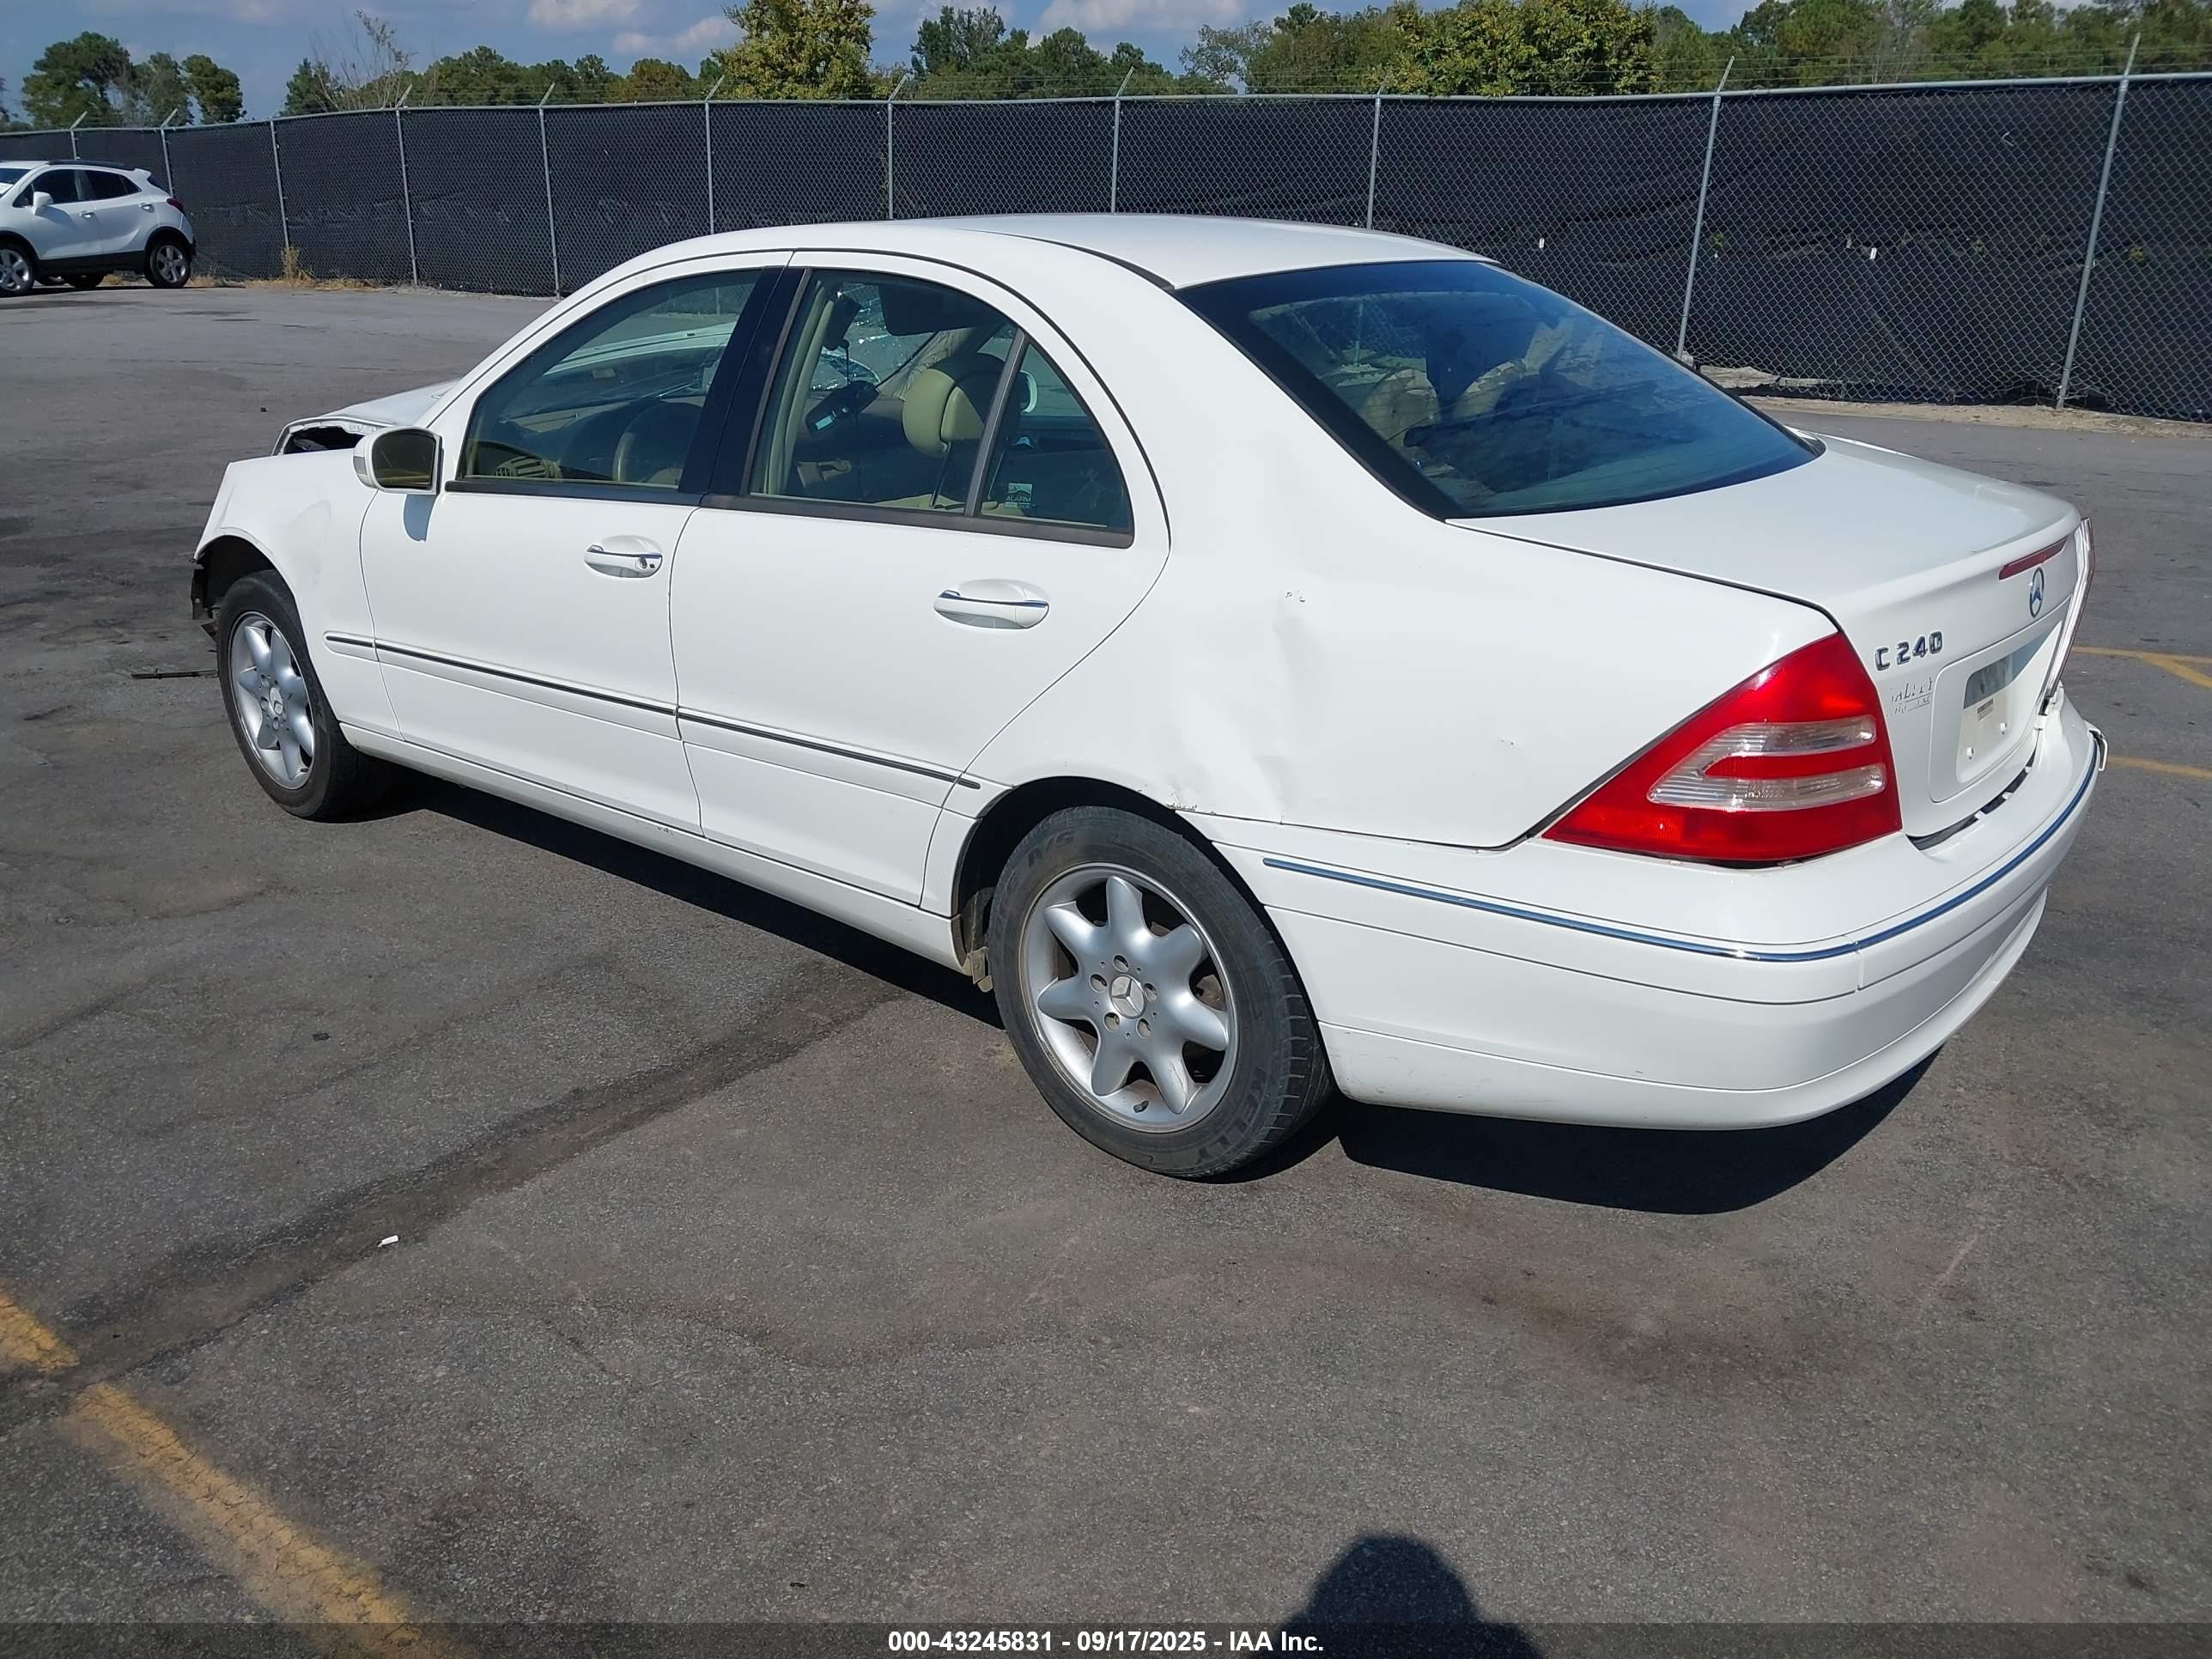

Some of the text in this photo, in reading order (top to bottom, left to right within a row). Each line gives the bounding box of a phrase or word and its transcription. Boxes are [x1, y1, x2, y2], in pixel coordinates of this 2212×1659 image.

[1006, 495, 1031, 503] ALARM
[1875, 630, 1943, 672] C 240
[1195, 1065, 1268, 1165] KELLY
